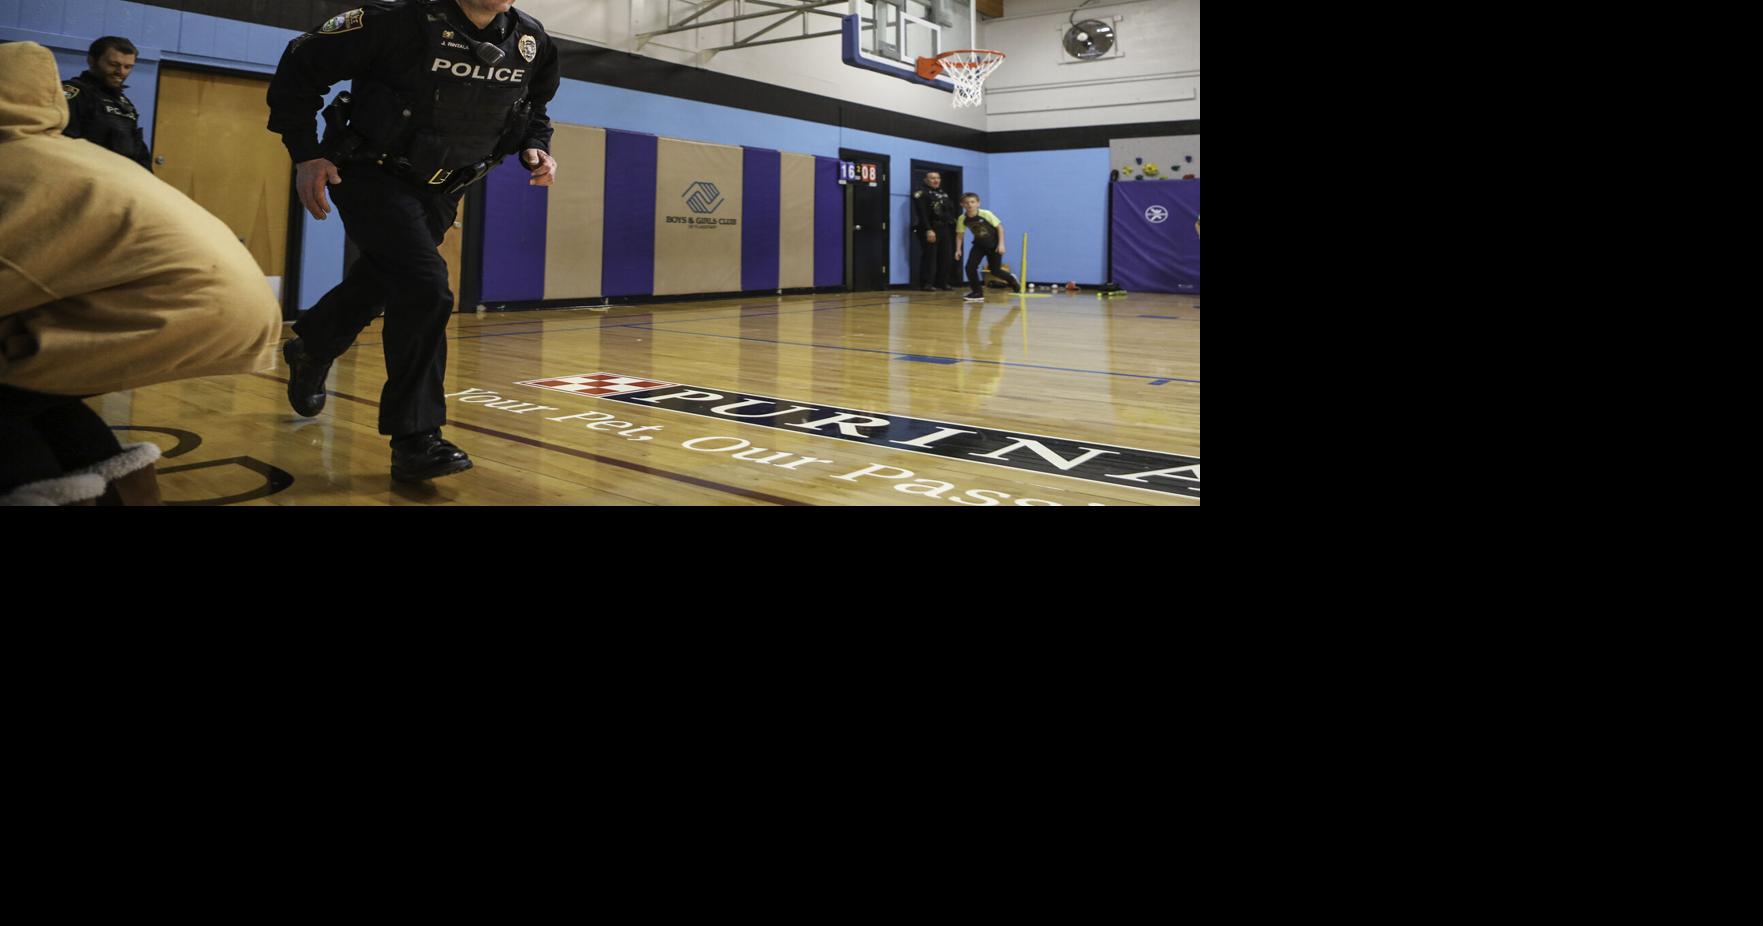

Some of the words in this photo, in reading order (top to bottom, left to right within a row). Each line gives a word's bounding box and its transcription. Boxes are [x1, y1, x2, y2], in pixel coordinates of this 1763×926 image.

[431, 58, 525, 82] POLICE
[841, 164, 855, 179] 16
[861, 165, 876, 181] 08
[666, 215, 687, 224] BOYS
[695, 217, 717, 225] GIRLS
[444, 387, 560, 414] Your
[681, 436, 834, 470] Our
[630, 389, 1200, 491] PURINA
